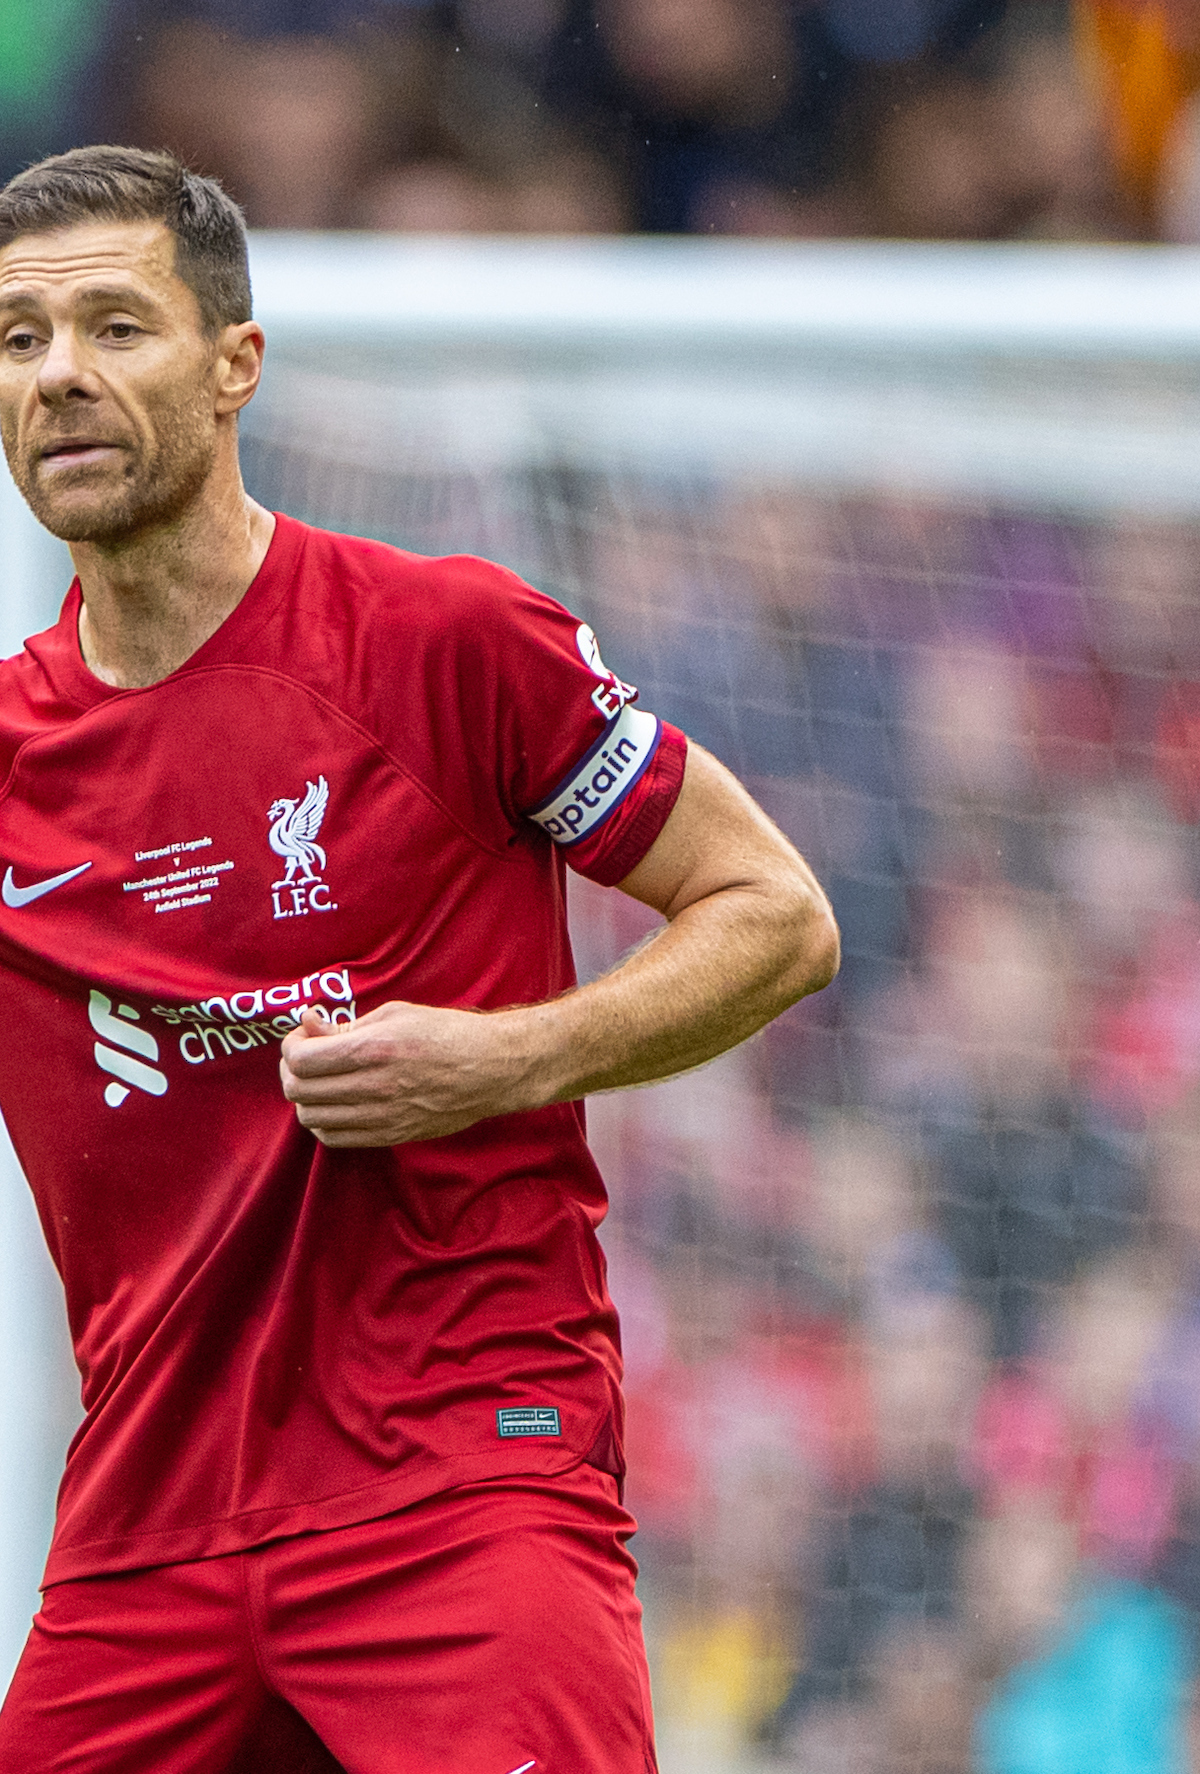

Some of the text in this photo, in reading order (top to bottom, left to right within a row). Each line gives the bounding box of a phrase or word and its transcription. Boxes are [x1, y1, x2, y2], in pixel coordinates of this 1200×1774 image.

[543, 737, 638, 835] aptain
[135, 836, 212, 861] Liverpool FC Legends
[123, 860, 235, 892] Manchester United FC Legends
[161, 883, 199, 897] September
[155, 893, 211, 913] Anfield Stadium
[272, 884, 338, 919] L.F.C.
